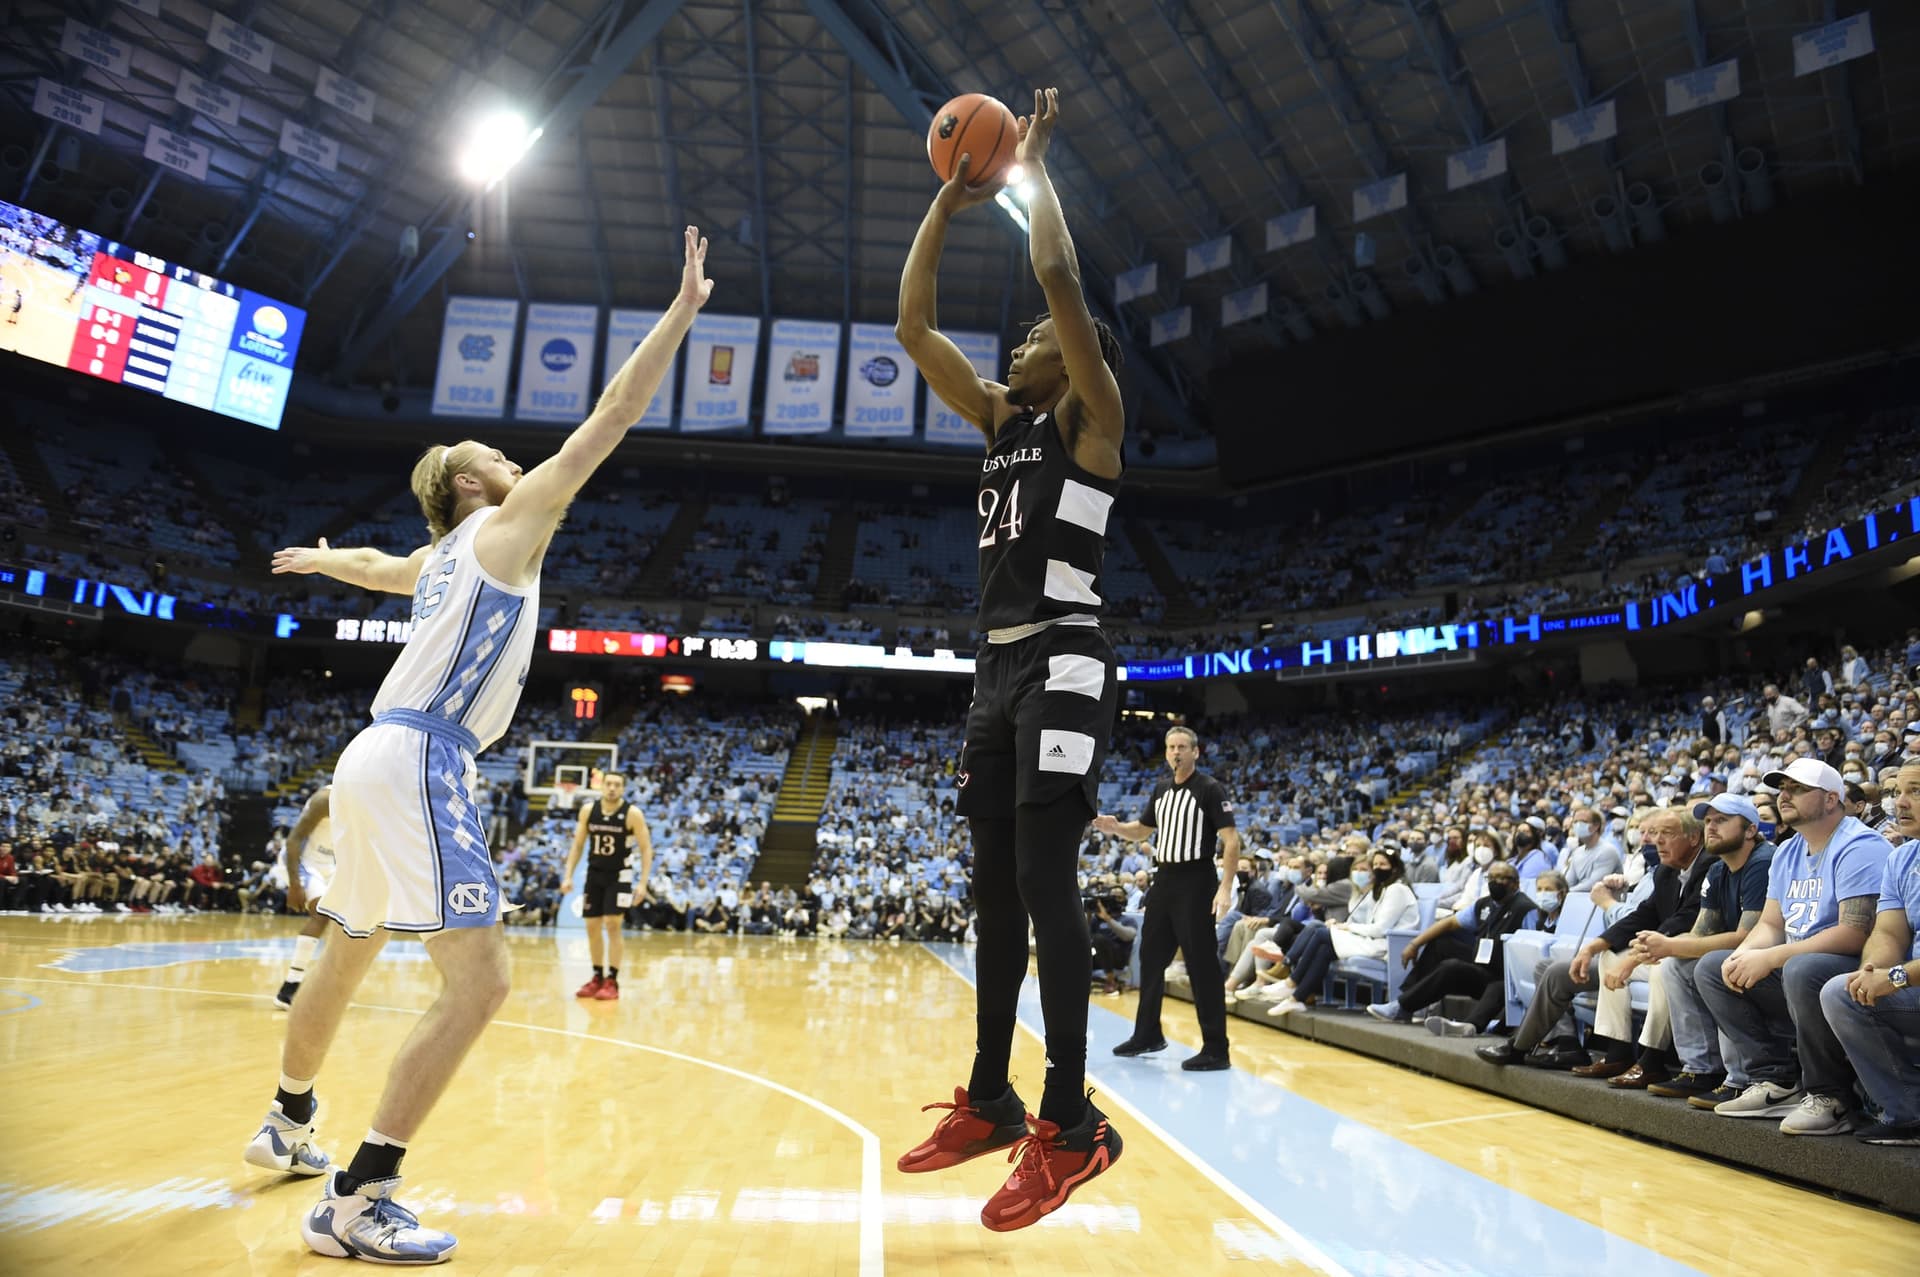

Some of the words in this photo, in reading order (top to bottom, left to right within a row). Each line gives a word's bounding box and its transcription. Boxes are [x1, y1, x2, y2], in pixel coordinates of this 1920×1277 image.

[531, 390, 579, 408] 1957
[696, 400, 738, 416] 1993
[776, 403, 821, 420] 2005
[855, 405, 905, 423] 2009
[977, 479, 1023, 548] 24
[1542, 620, 1566, 632] UNC
[1569, 613, 1621, 629] HEALTH
[1148, 664, 1184, 675] HEALTH
[1046, 751, 1067, 759] adidas
[593, 834, 616, 856] 13
